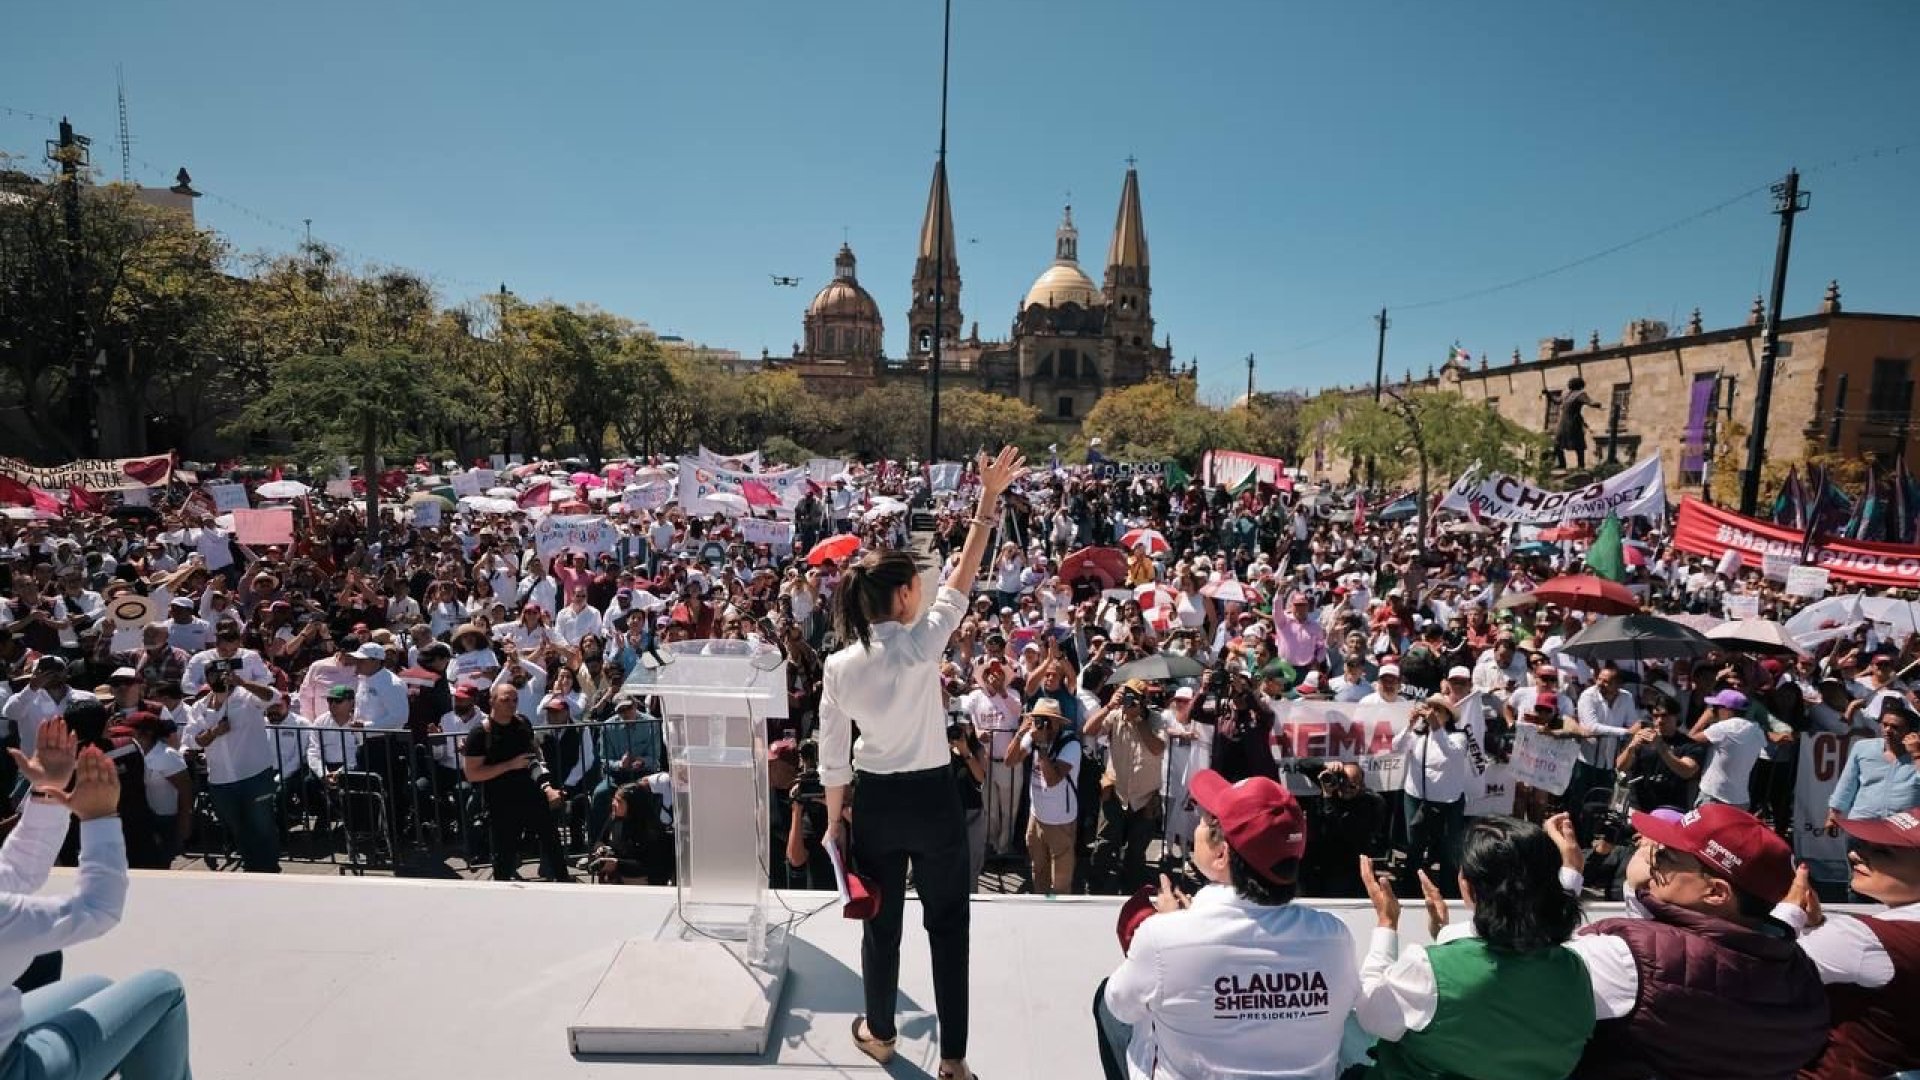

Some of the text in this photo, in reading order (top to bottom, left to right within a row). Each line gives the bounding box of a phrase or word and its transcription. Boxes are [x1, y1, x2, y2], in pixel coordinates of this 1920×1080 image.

[1715, 524, 1920, 577] #MagisterioCo
[1269, 721, 1393, 757] HEMA
[1214, 971, 1329, 996] CLAUDIA
[1214, 992, 1329, 1011] SHEINBAUM
[1239, 1010, 1306, 1021] PRESIDENTA
